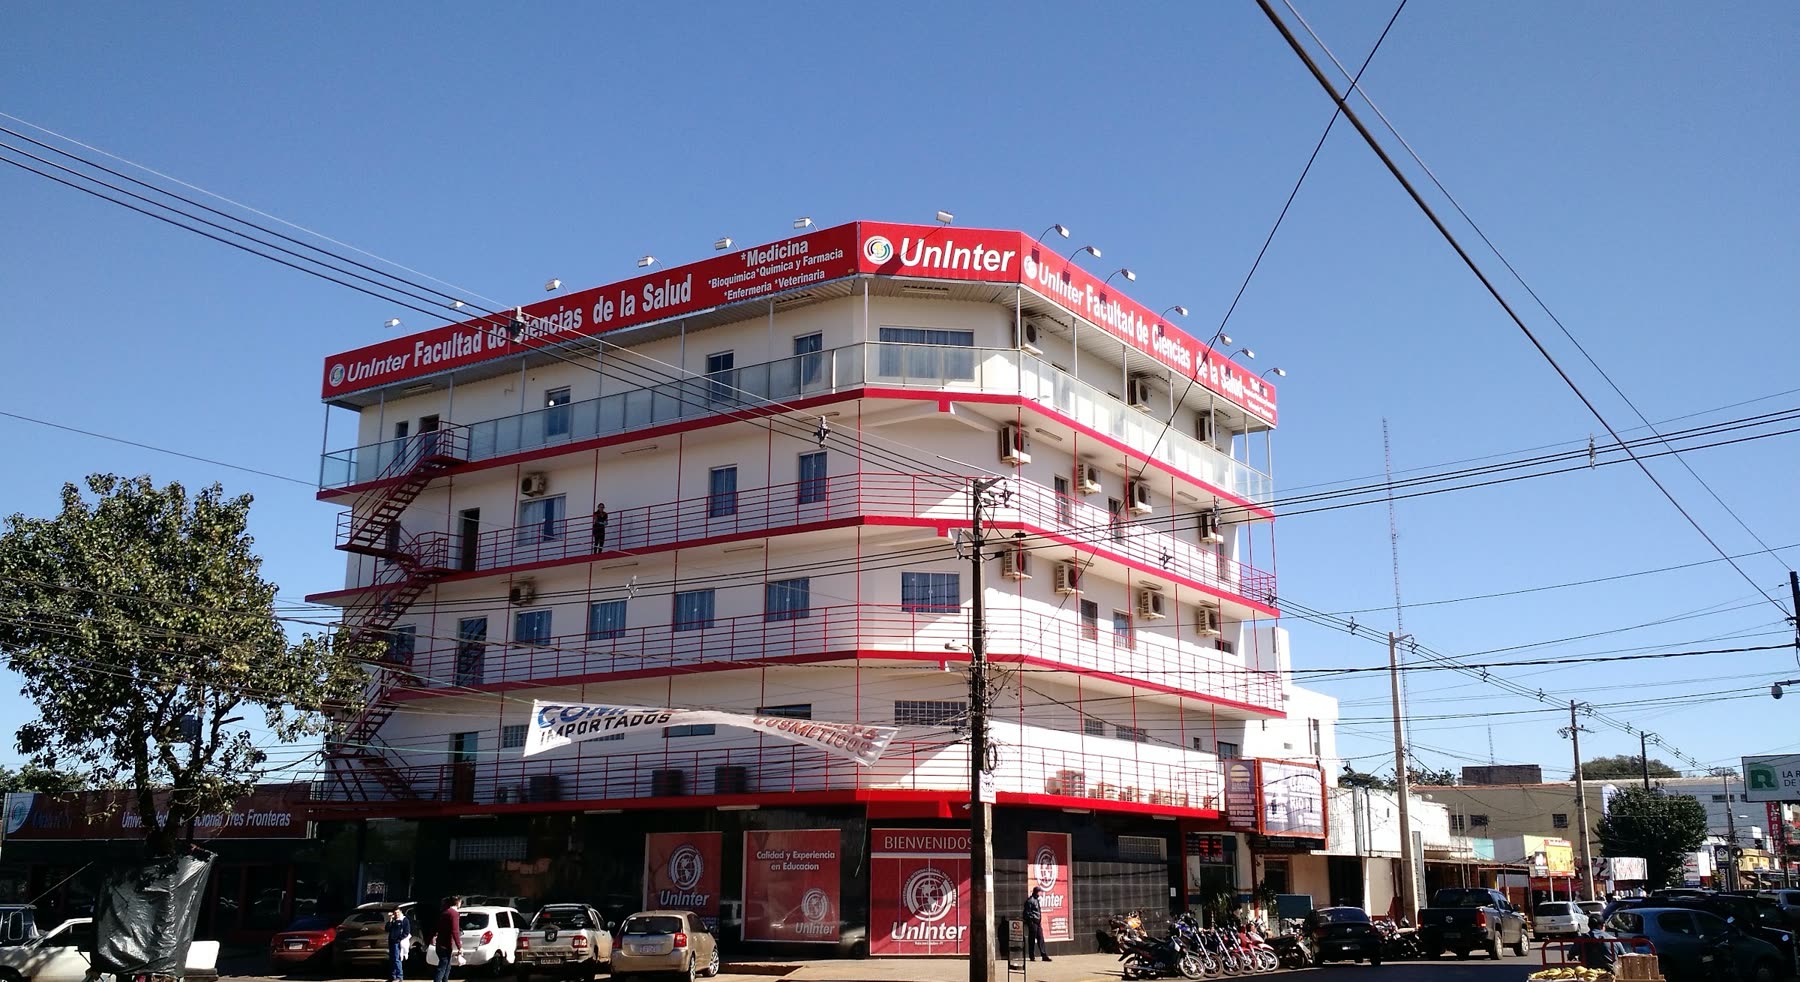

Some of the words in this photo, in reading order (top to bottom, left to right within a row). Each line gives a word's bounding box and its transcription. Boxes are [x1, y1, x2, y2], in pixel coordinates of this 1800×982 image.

[795, 259, 801, 271] y
[802, 248, 844, 263] Farmacia
[900, 237, 1016, 272] UnInter
[347, 353, 411, 382] UnInter
[413, 325, 482, 367] Facultad
[487, 323, 506, 349] de
[592, 295, 614, 324] de
[619, 290, 635, 318] la
[642, 273, 692, 313] Salud
[1037, 265, 1084, 306] UnInter
[1086, 284, 1134, 337] Facultad
[1136, 315, 1149, 345] de
[1151, 323, 1191, 370] Ciencias
[1195, 351, 1208, 377] de
[1209, 357, 1218, 385] la
[1782, 770, 1793, 778] LA
[1784, 779, 1797, 787] DE
[246, 808, 292, 828] Fronteras
[756, 851, 784, 860] Calidad
[785, 852, 791, 861] y
[792, 850, 836, 862] Experiencia
[770, 863, 781, 871] en
[660, 890, 710, 906] UnInter
[795, 922, 835, 935] UnInter
[891, 921, 967, 940] UnInter
